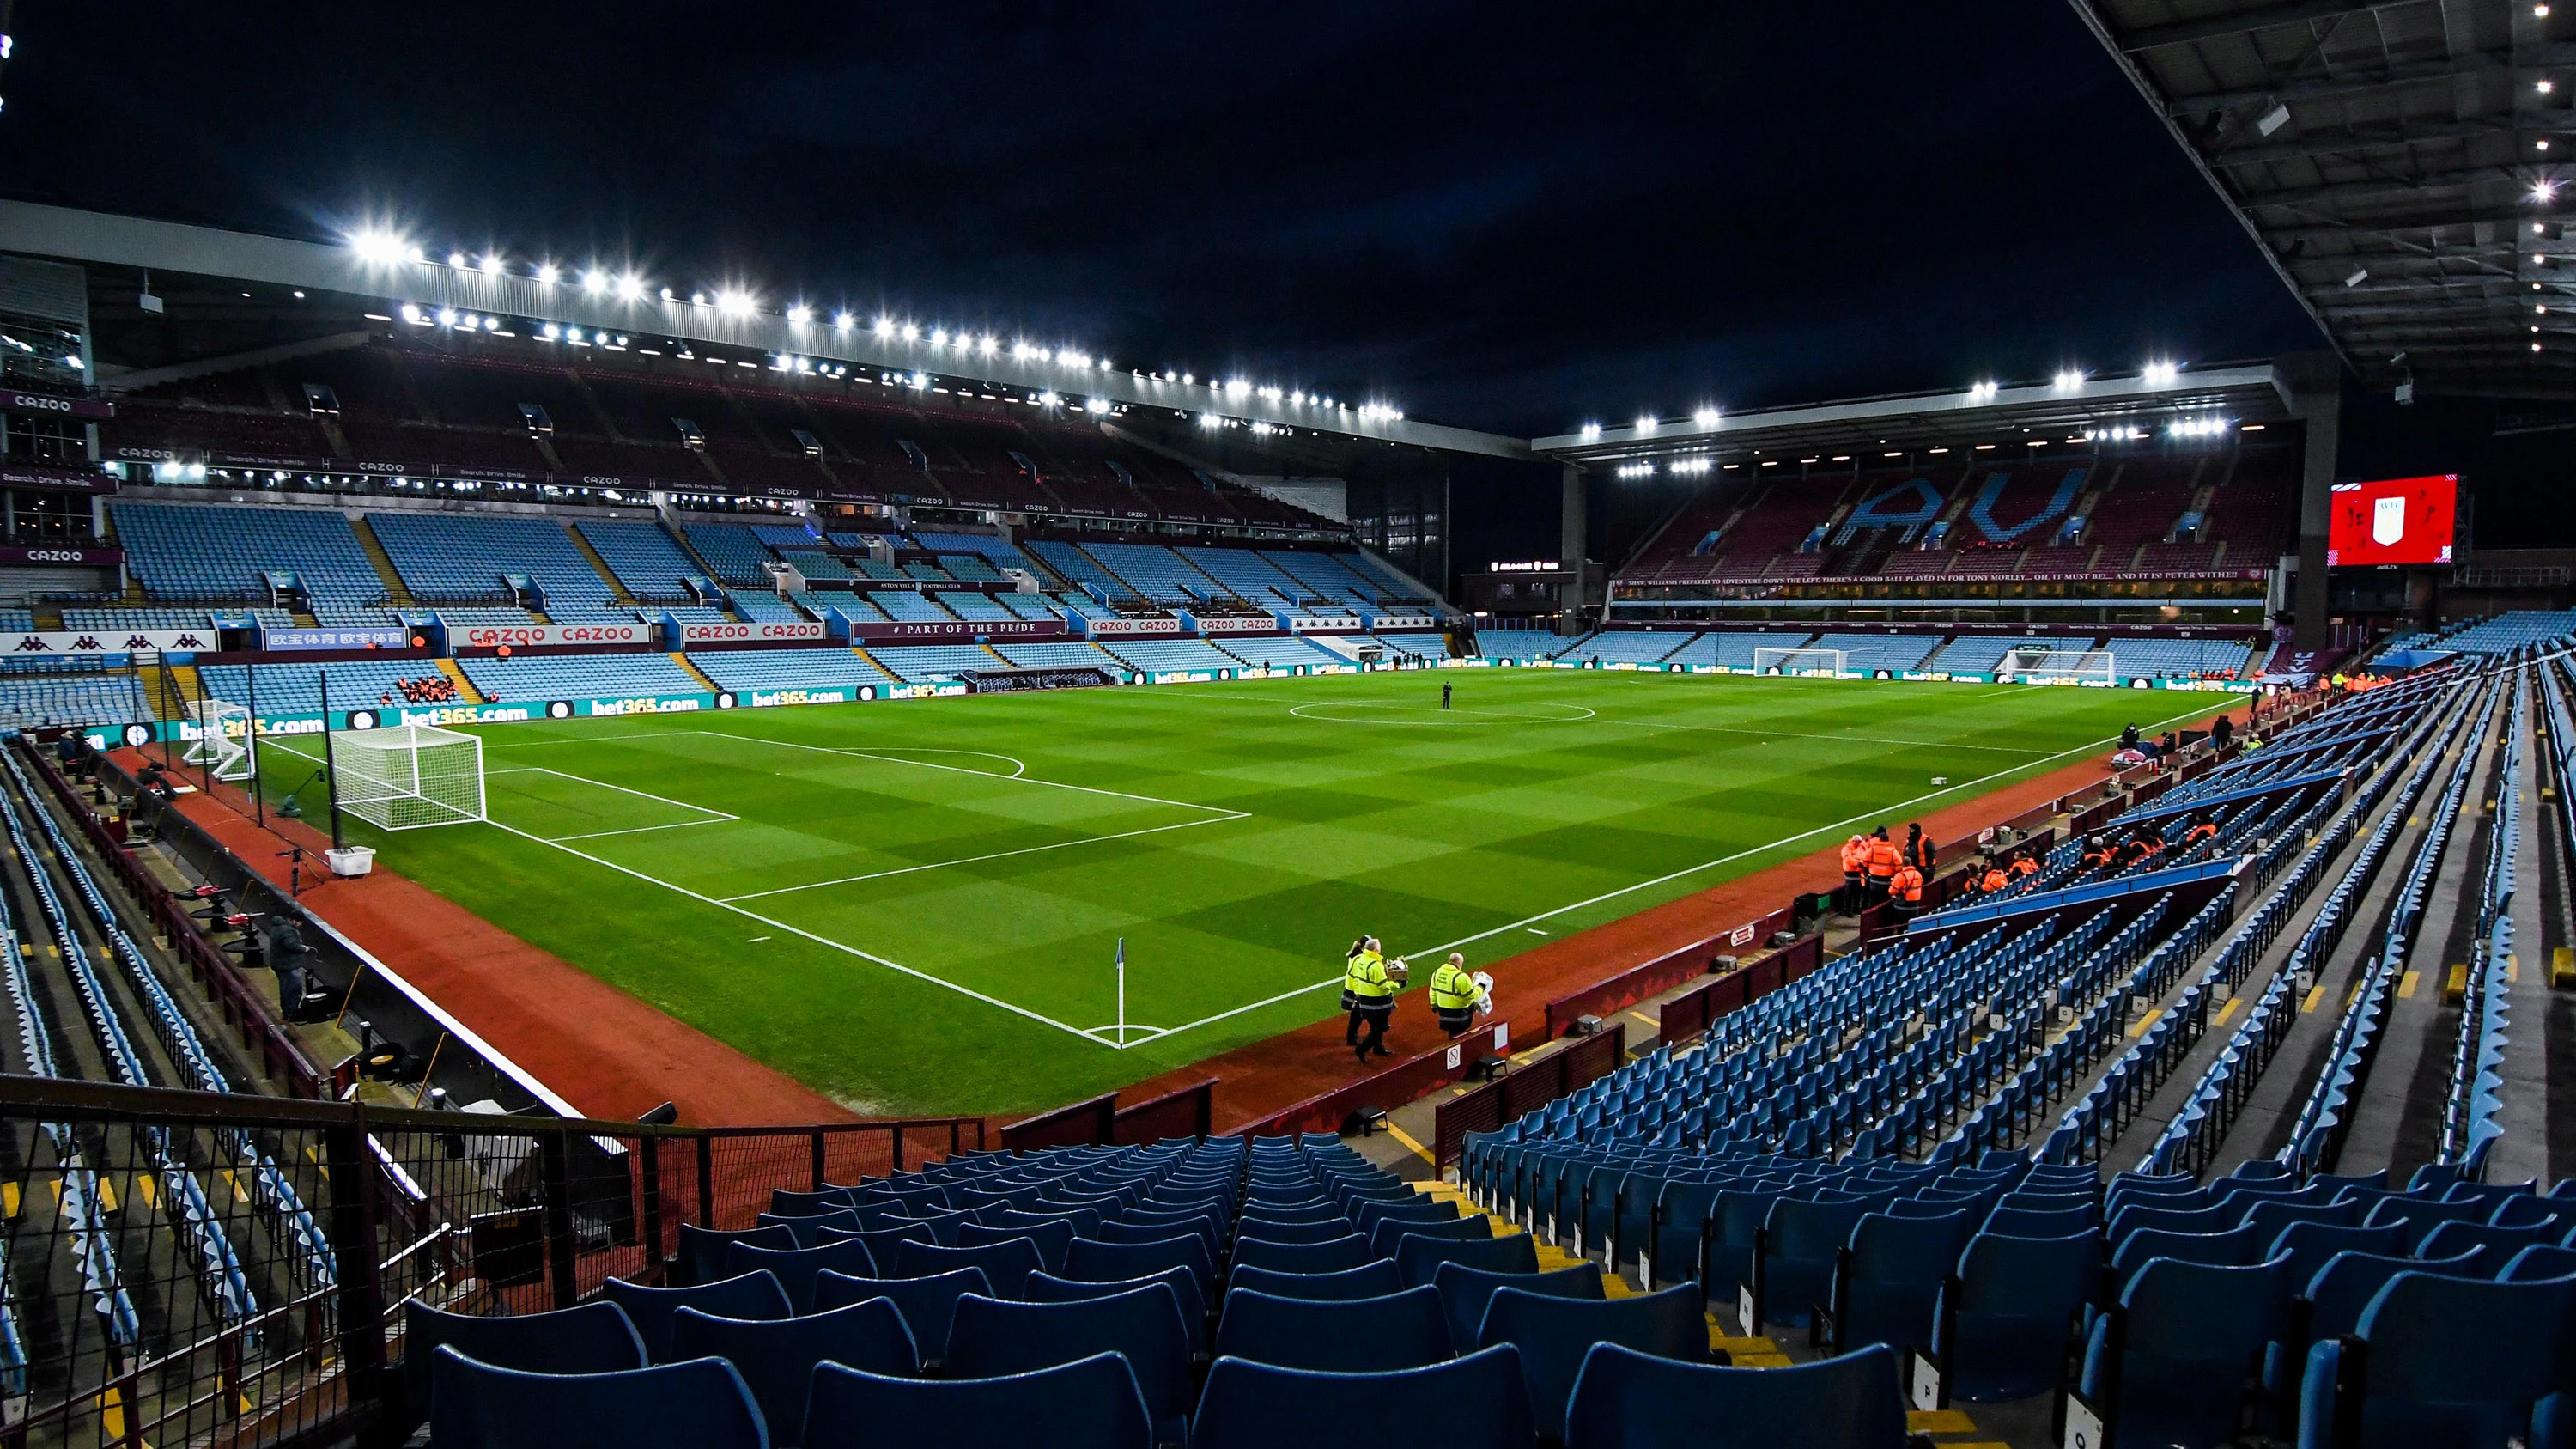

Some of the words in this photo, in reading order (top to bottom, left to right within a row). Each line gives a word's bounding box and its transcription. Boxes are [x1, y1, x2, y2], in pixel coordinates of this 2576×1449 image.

[15, 395, 70, 411] CAZOO
[118, 447, 173, 459] CAZOO
[359, 462, 404, 472] CAZOO
[583, 476, 621, 485] CAZOO
[768, 487, 799, 496] CAZOO
[27, 550, 82, 562] CAZOO
[907, 625, 939, 634] PART
[946, 624, 962, 633] OF
[969, 624, 993, 632] THE
[1092, 621, 1132, 631] CAZOO
[1139, 621, 1176, 630] CAZOO
[1202, 620, 1235, 630] CAZOO
[1242, 620, 1273, 629] CAZOO
[469, 629, 545, 642] CAZOO
[562, 628, 633, 640] CAZOO
[687, 625, 750, 638] CAZOO
[762, 625, 820, 637] CAZOO
[270, 633, 336, 644] 欧宝体育
[340, 632, 402, 644] 欧宝体育
[1155, 672, 1211, 684] bet365.com
[752, 691, 844, 707] bet365.com
[592, 697, 699, 715] bet365.com
[401, 706, 528, 726] bet365.com
[1925, 1385, 1931, 1397] P
